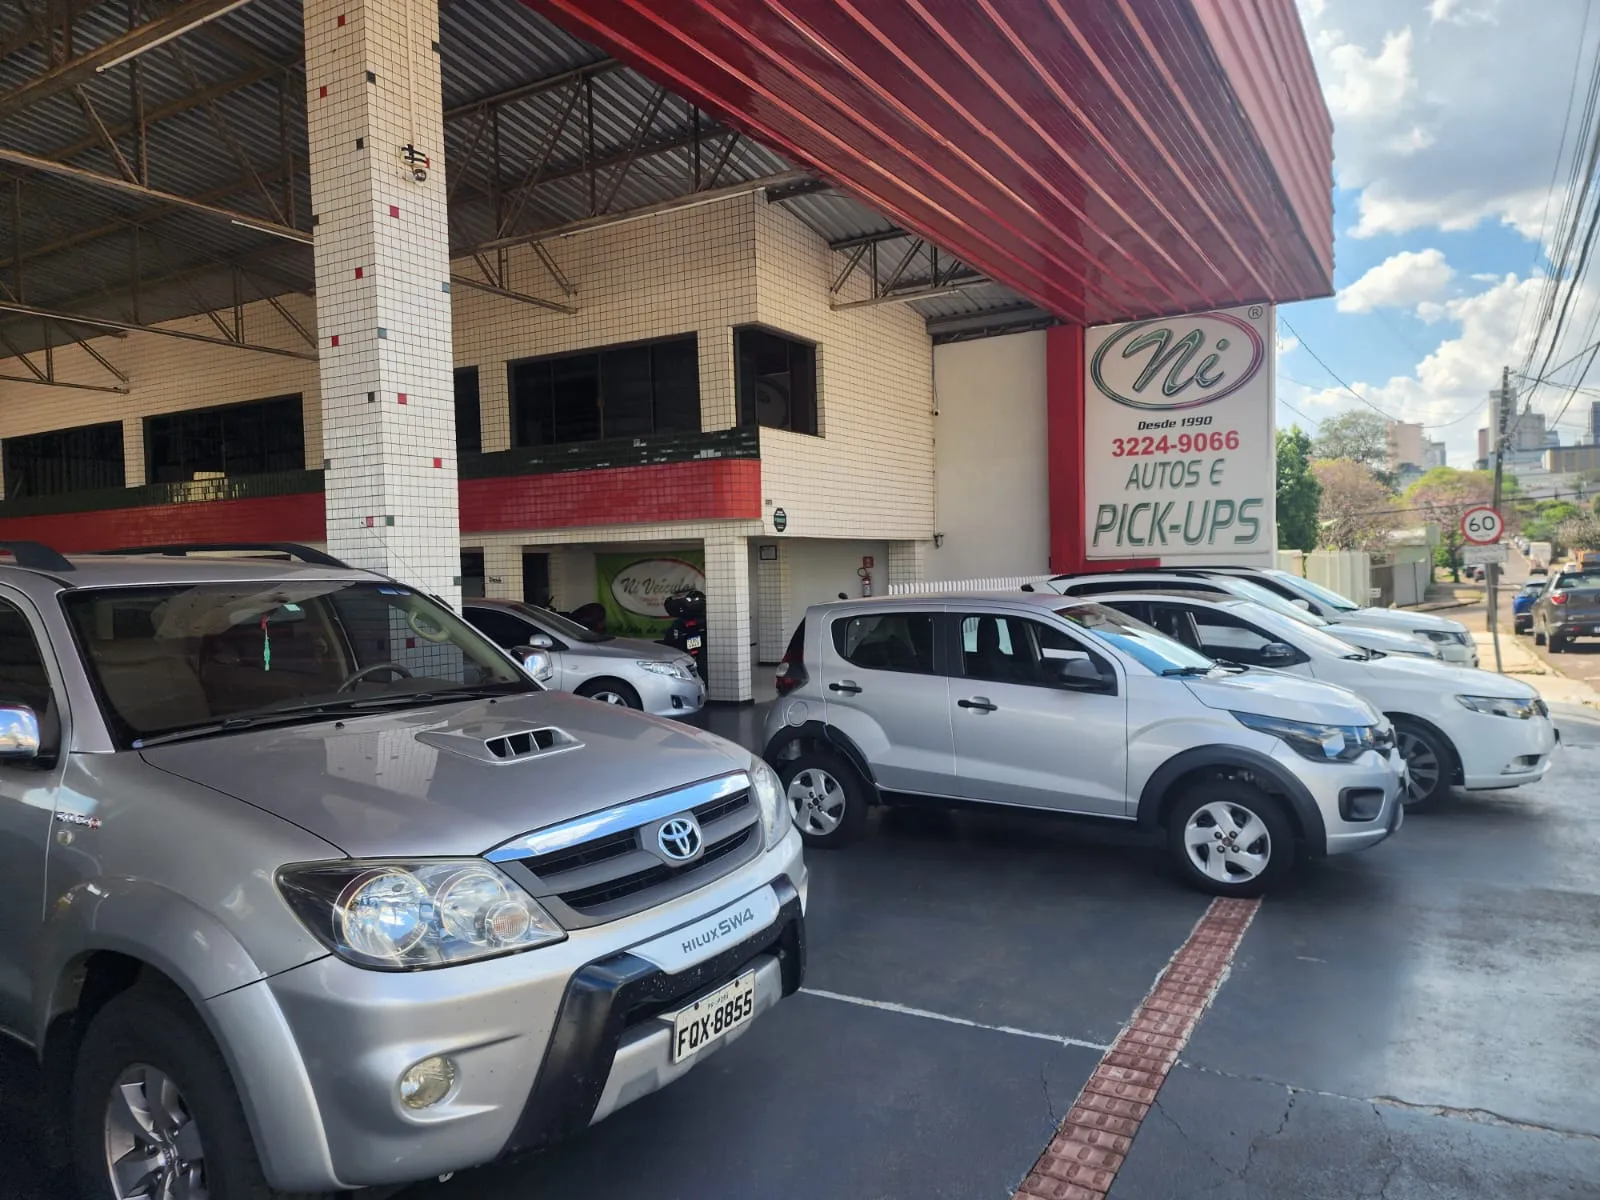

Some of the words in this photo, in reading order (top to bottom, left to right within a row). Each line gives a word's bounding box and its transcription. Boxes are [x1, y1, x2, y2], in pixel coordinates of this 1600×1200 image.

[1122, 328, 1230, 396] Ni
[1137, 420, 1177, 431] Desde
[1181, 416, 1213, 428] 1990
[1111, 430, 1240, 457] 3224-9066
[1125, 459, 1203, 491] AUTOS
[1092, 498, 1263, 547] PICK-UPS
[1469, 516, 1495, 532] 60
